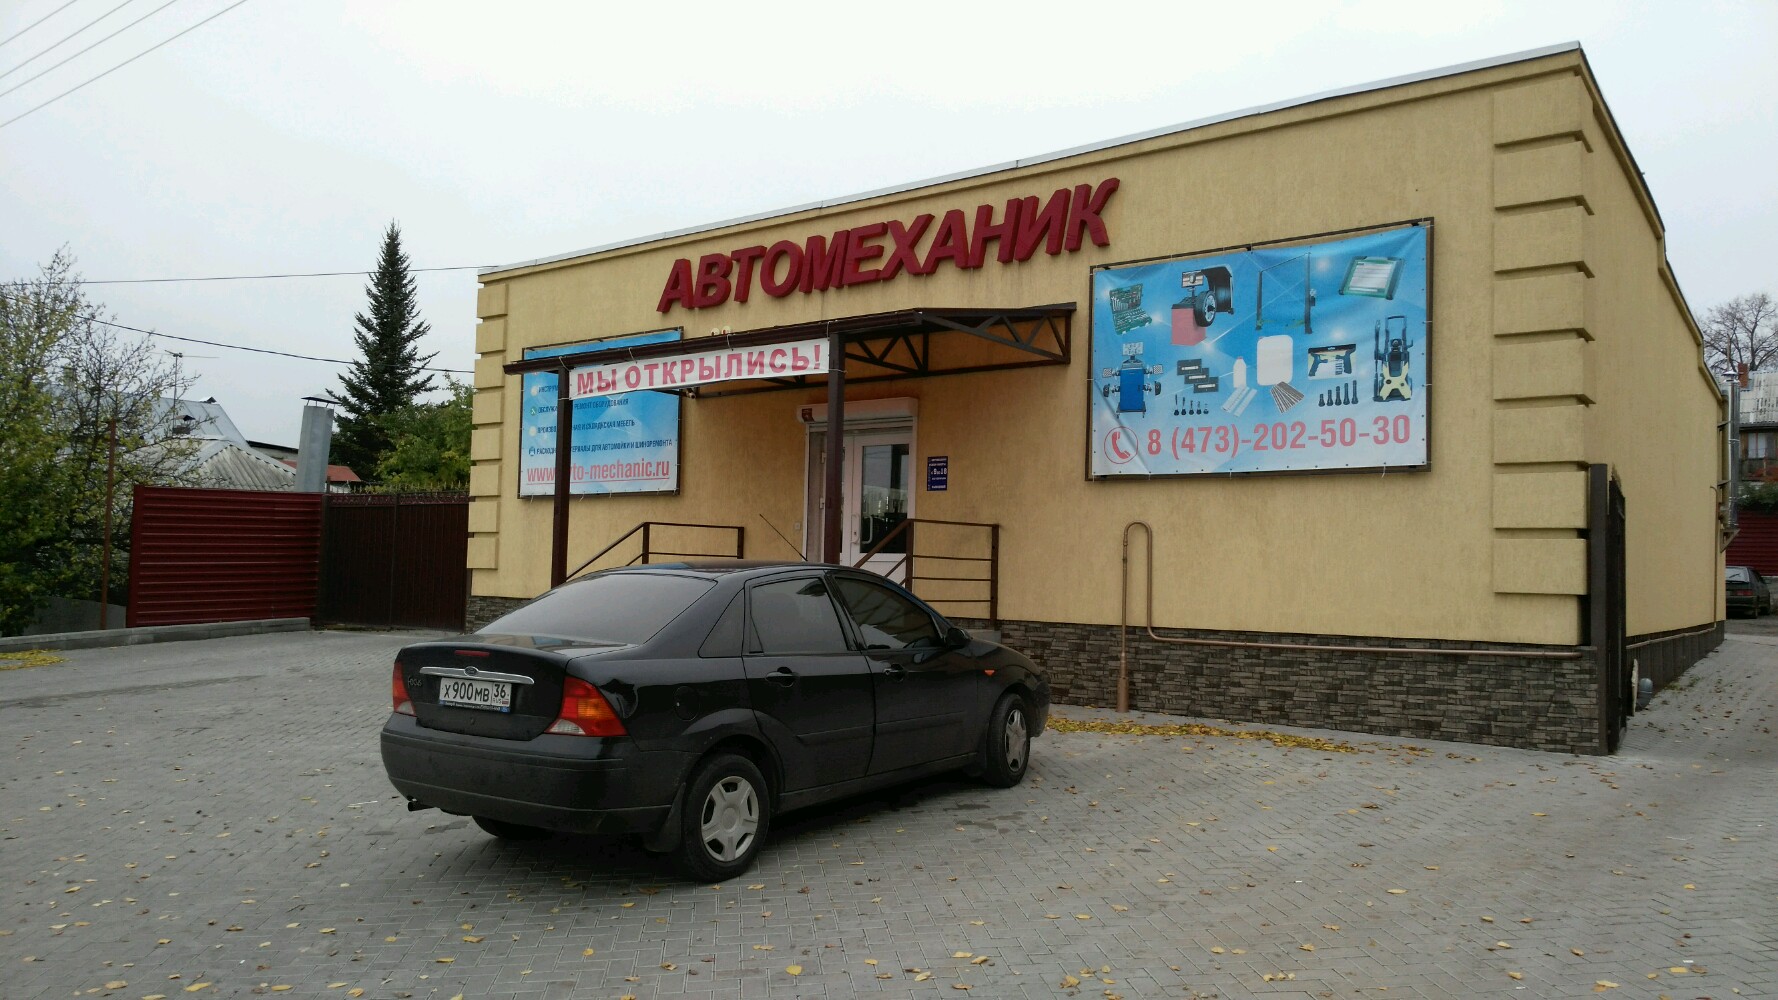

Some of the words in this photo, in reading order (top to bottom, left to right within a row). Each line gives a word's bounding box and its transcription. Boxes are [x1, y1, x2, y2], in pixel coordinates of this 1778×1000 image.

[656, 177, 1120, 313] АВТОМЕХАНИК
[577, 368, 617, 395] МЫ
[625, 344, 821, 390] ОТКРЫЛИСЬ!
[616, 419, 635, 427] МЕБЕЛЬ
[1147, 429, 1161, 456] 8
[1172, 414, 1411, 459] (473)-202-50-30
[493, 684, 507, 698] 36
